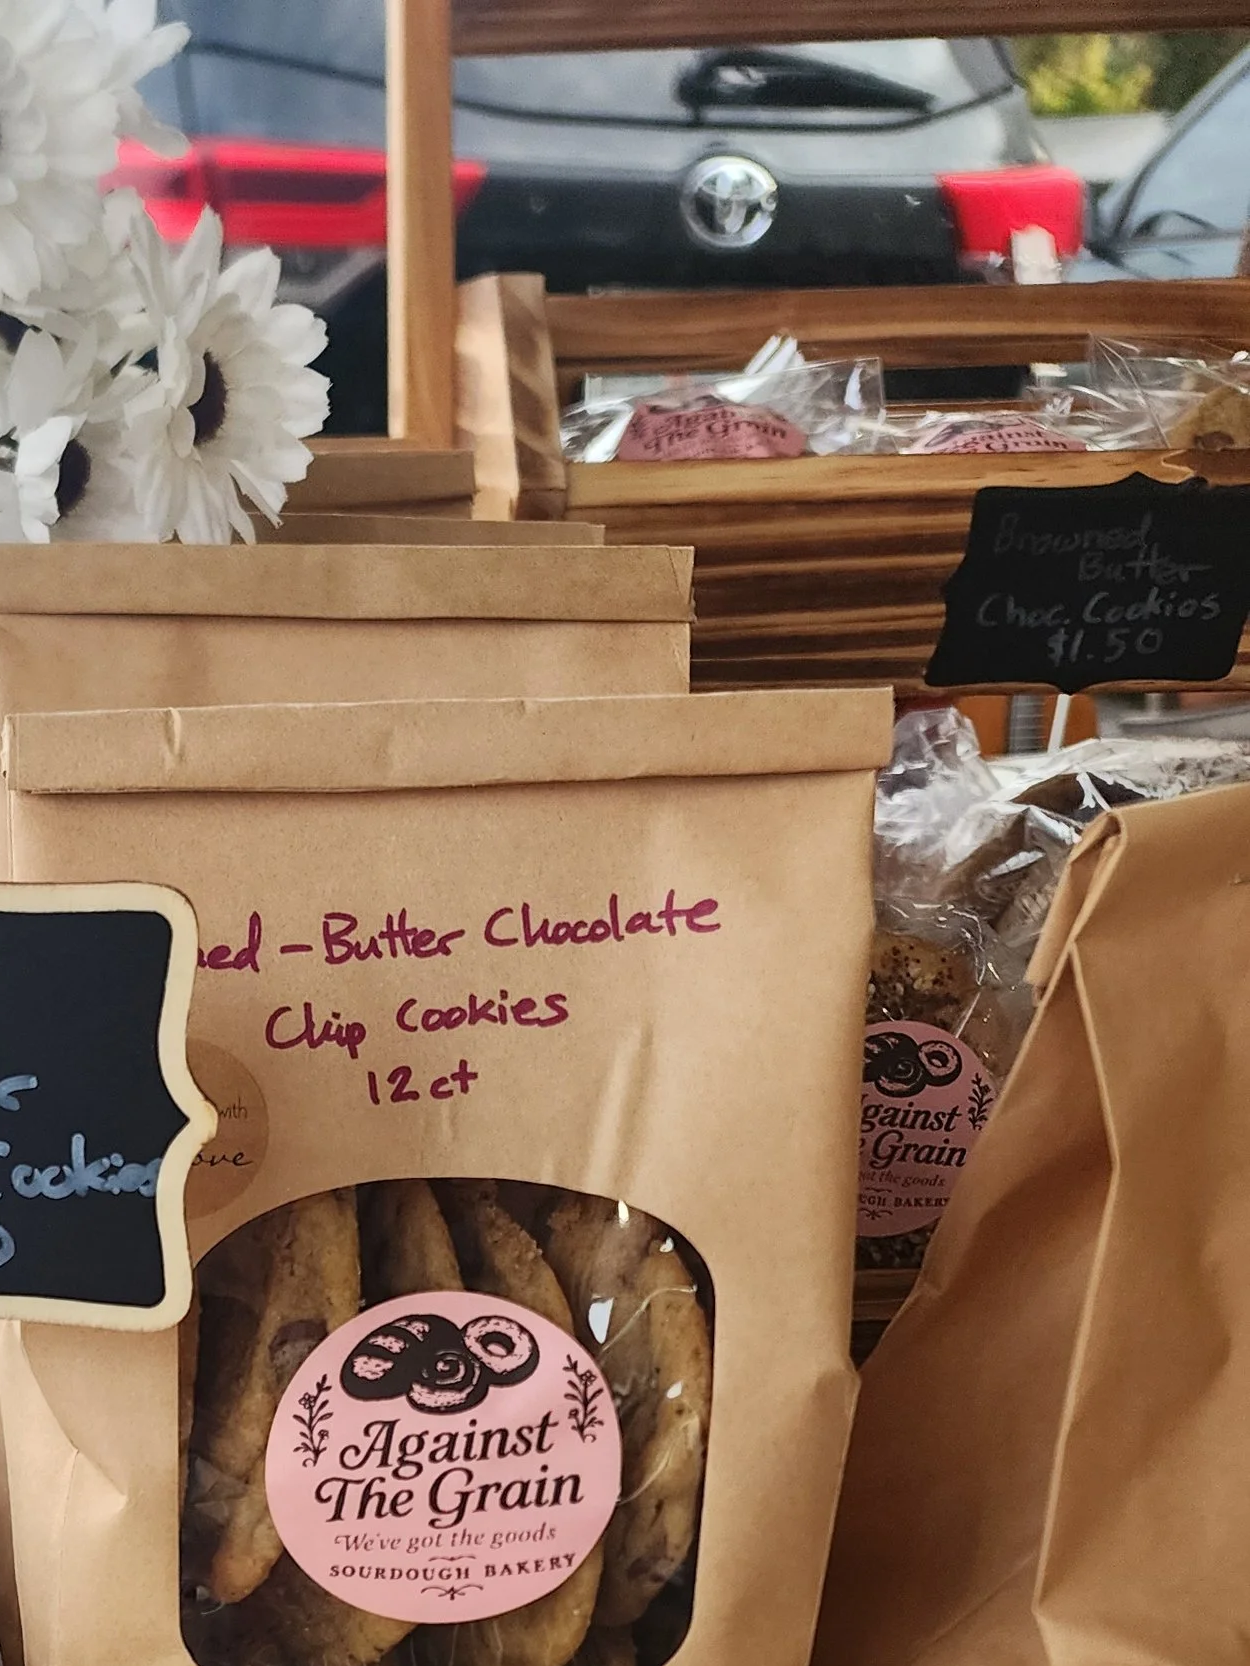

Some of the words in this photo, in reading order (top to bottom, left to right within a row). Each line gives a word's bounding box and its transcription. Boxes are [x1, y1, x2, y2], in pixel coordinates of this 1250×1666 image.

[994, 512, 1152, 554] Browned
[1078, 543, 1213, 585] Butter
[976, 592, 1070, 628] Choc.
[1082, 587, 1221, 624] Cookies
[1048, 628, 1164, 667] $1.50
[484, 889, 722, 948] Chocolate
[265, 1002, 367, 1059] Chip
[396, 989, 569, 1032] Cookies
[861, 1093, 963, 1133] gainst
[191, 1151, 254, 1167] ove
[869, 1129, 967, 1170] Grain
[902, 1174, 946, 1188] goods
[339, 1411, 560, 1480] Against
[315, 1476, 414, 1523] The
[428, 1464, 585, 1529] Grain
[334, 1532, 402, 1553] We've
[407, 1526, 444, 1554] got
[451, 1527, 486, 1548] the
[490, 1522, 557, 1550] goods
[329, 1563, 470, 1582] SOURDOUGH
[484, 1552, 577, 1578] BAKERY
